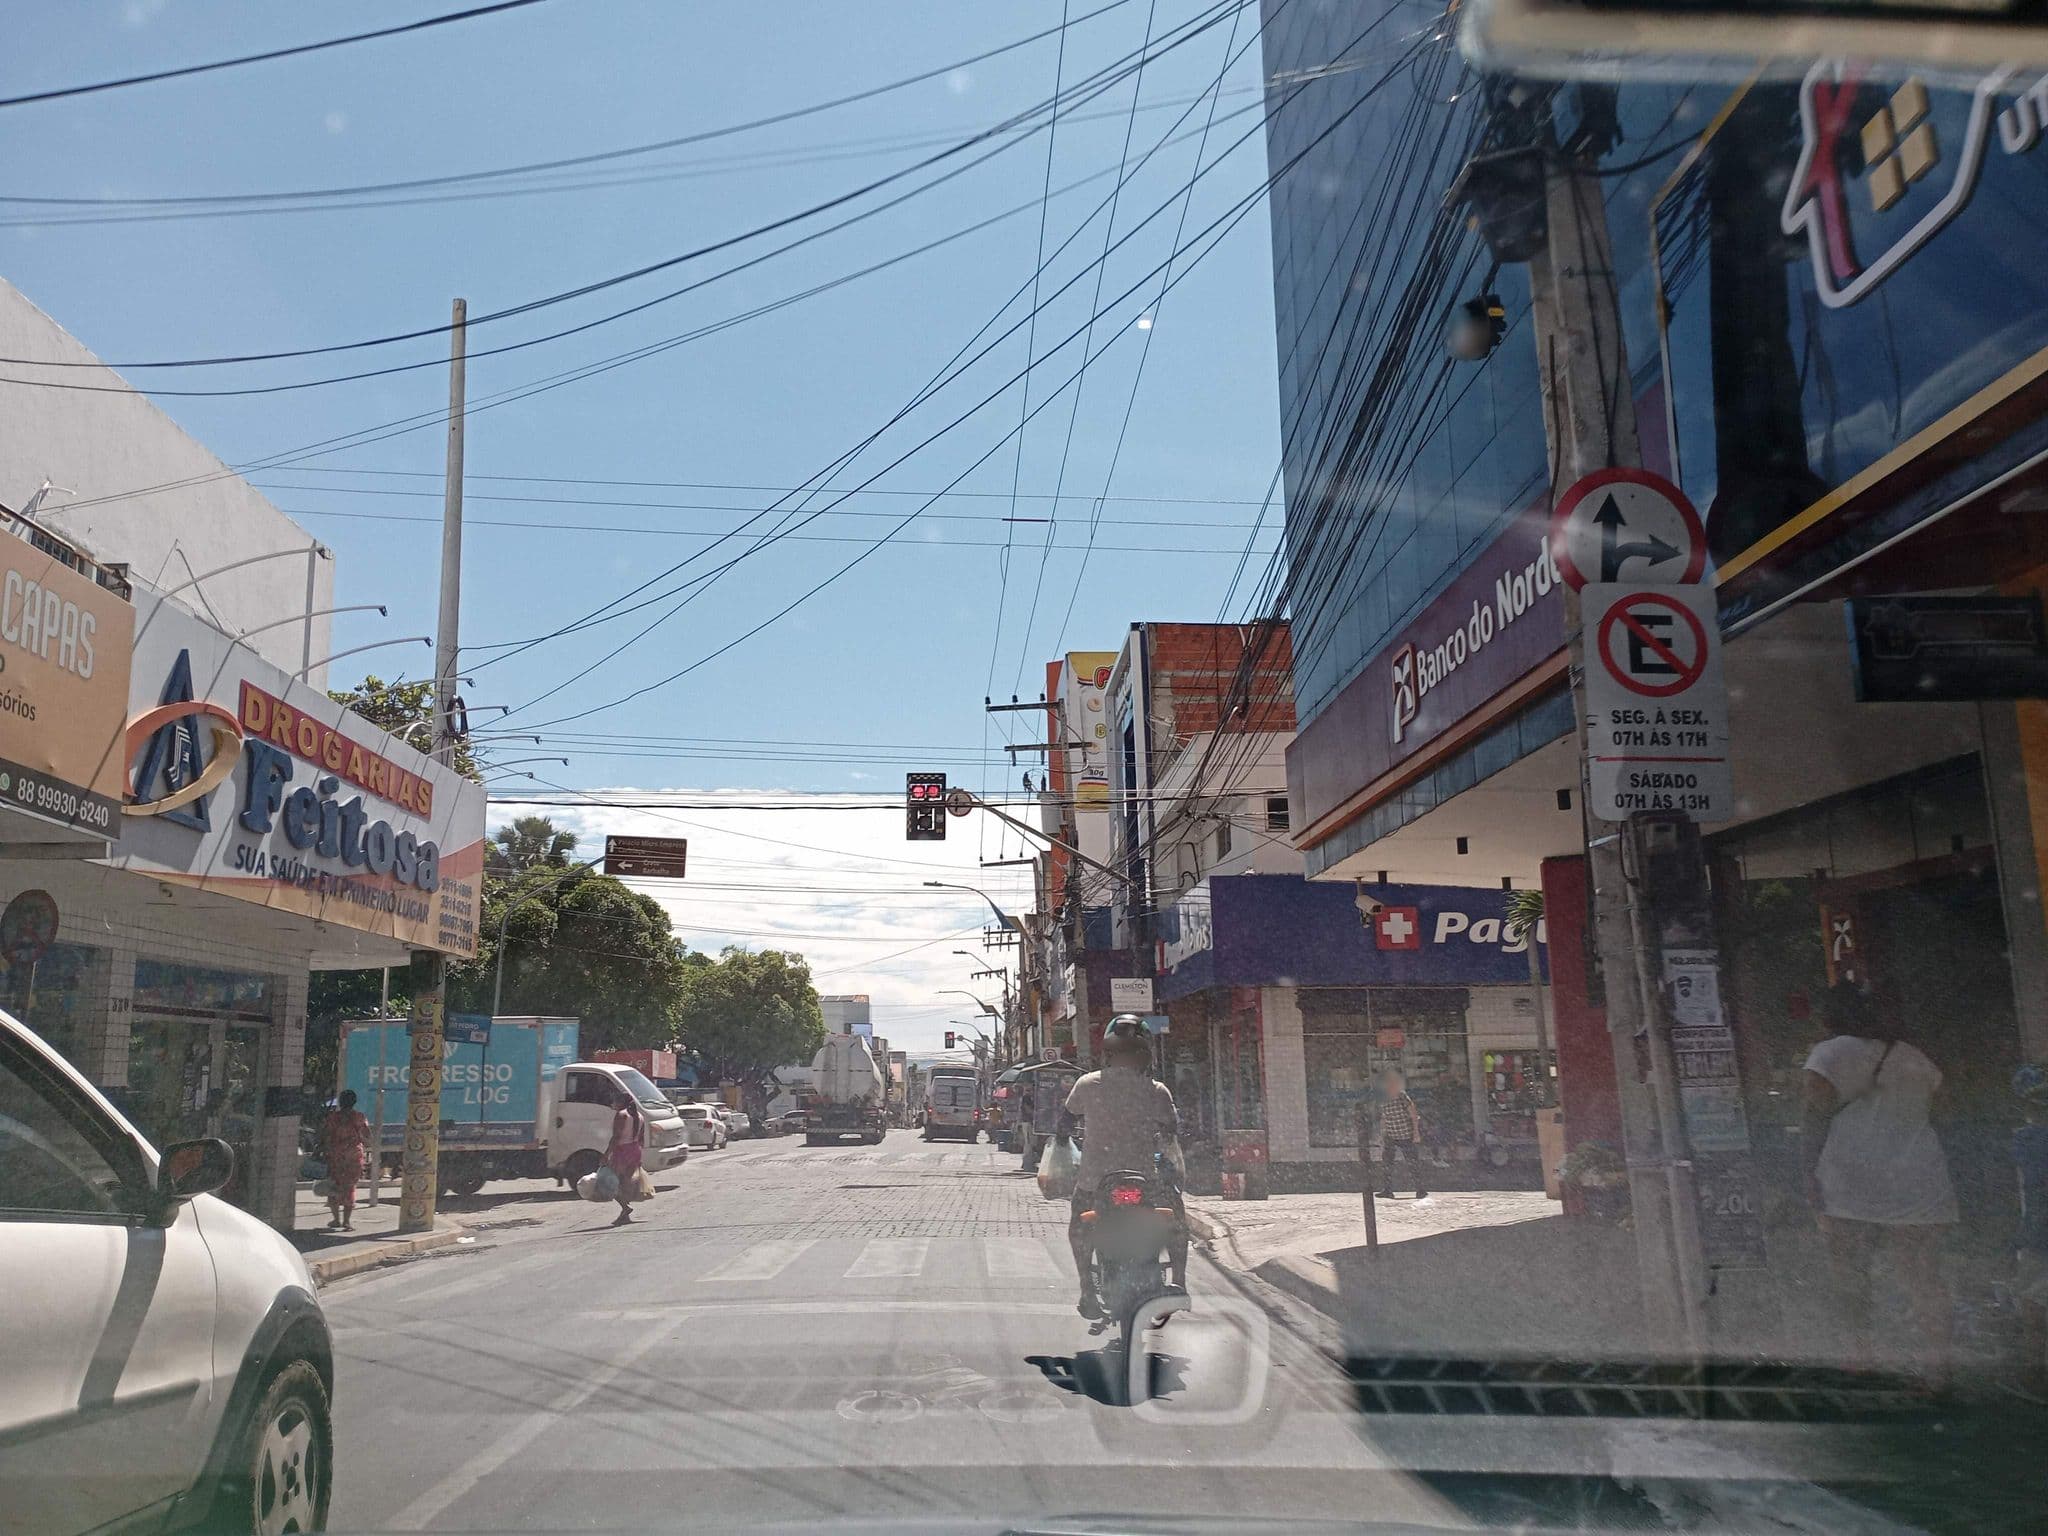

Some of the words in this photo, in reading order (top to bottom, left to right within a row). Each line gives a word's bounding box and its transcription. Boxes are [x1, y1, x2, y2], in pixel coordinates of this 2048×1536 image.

[1, 569, 97, 680] CAPAS
[1416, 628, 1466, 697] Banco
[1467, 599, 1494, 653] do
[1611, 709, 1649, 725] SEG.
[1655, 707, 1666, 725] À
[1671, 709, 1709, 725] SEX.
[244, 686, 432, 816] DROGARIAS
[1612, 731, 1644, 746] 07H
[1649, 728, 1672, 746] ÀS
[1677, 731, 1708, 746] 17H
[1630, 769, 1698, 789] SÁBADO
[18, 777, 35, 803] 88
[37, 785, 109, 828] 99930-6240
[239, 737, 440, 893] Feitosa
[1615, 793, 1647, 809] 07H
[1678, 794, 1710, 810] 13H
[234, 844, 266, 878] SUA
[268, 855, 318, 890] SAÚDE
[340, 878, 396, 913] PRIMEIRO
[396, 896, 430, 925] LUGAR
[368, 1063, 513, 1085] PRORESSO
[463, 1085, 511, 1105] LOG
